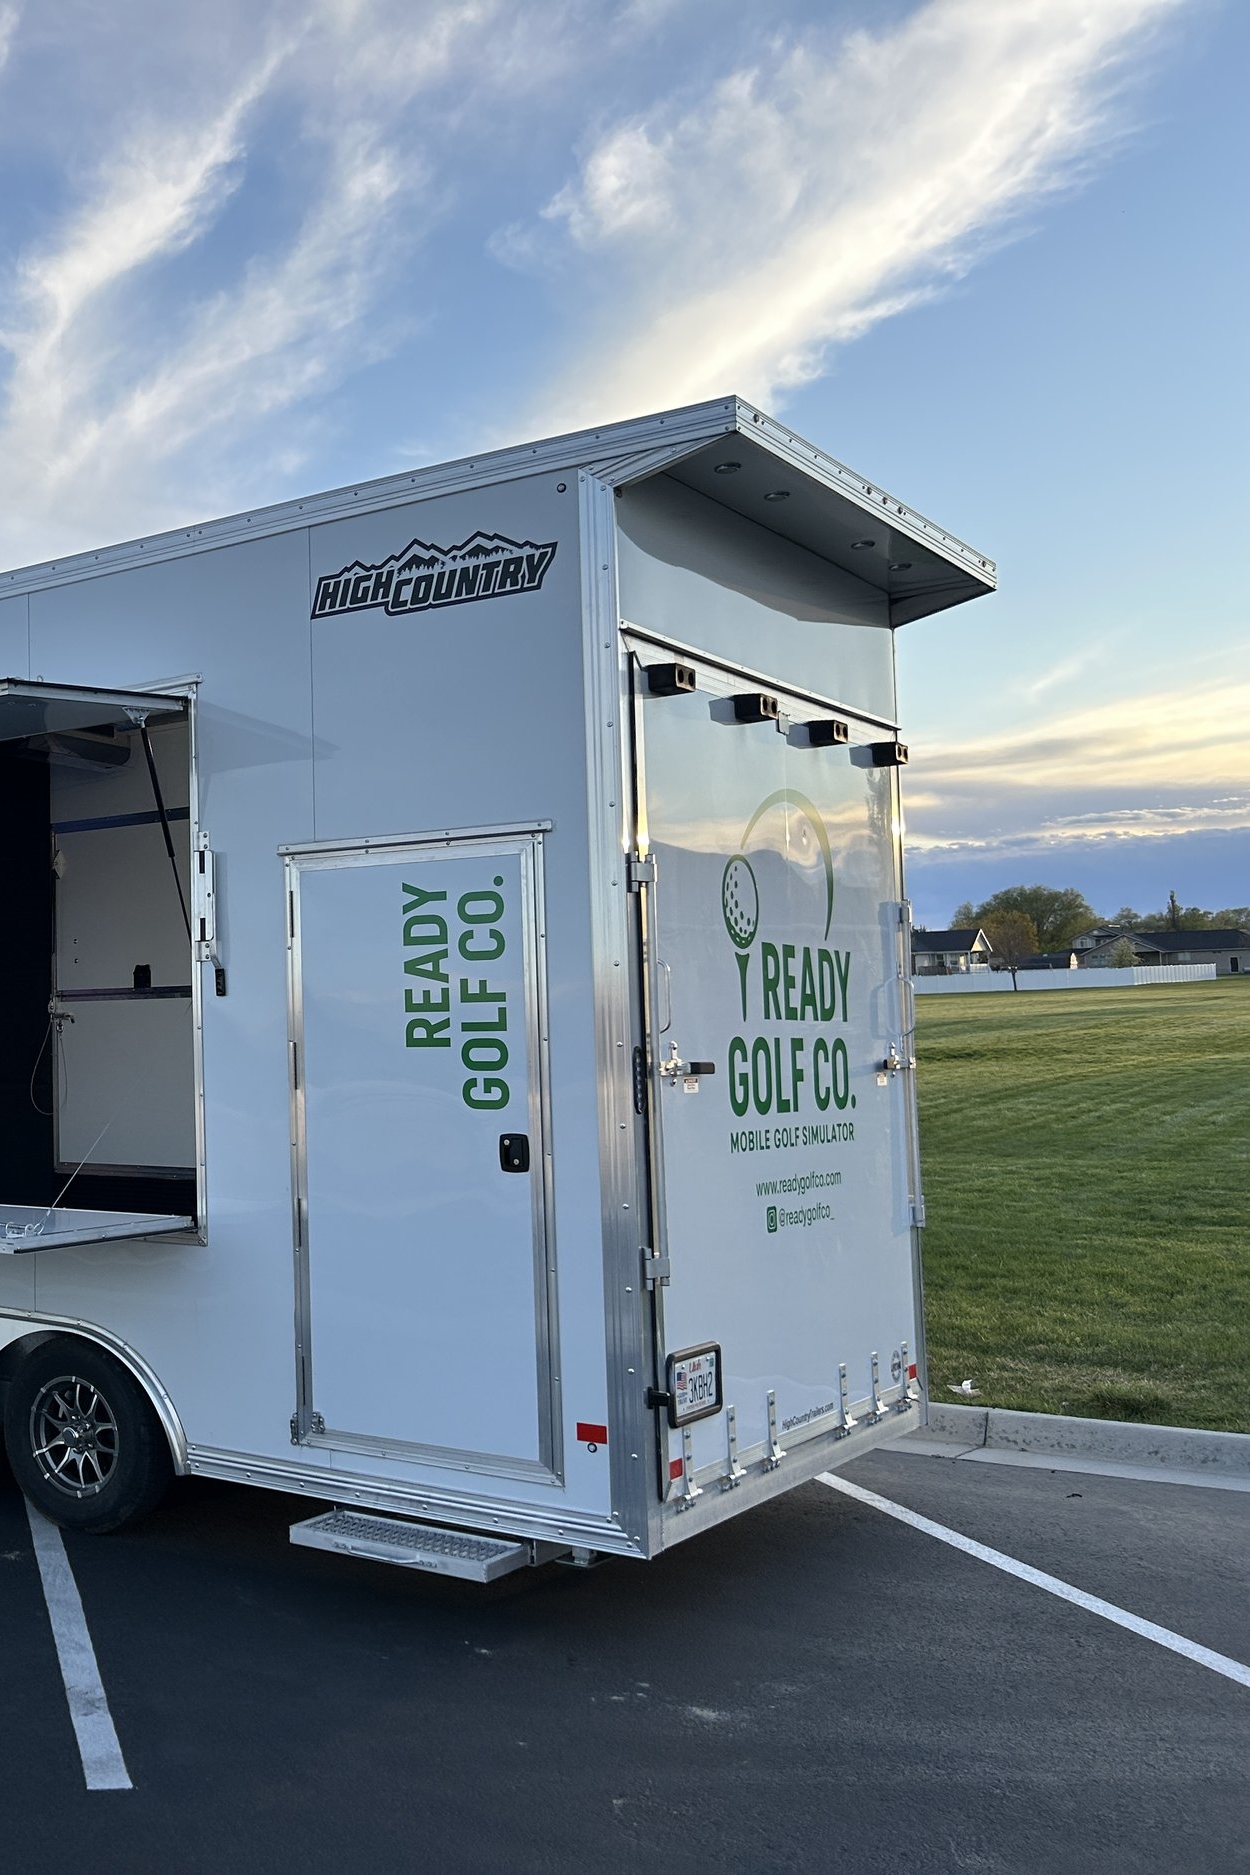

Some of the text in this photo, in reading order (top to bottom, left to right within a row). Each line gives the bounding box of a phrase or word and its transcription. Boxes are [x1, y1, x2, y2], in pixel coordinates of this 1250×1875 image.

[401, 881, 452, 1048] READY
[457, 875, 511, 1111] GOLF CO.
[761, 941, 851, 1023] READY
[727, 1036, 857, 1118] GOLF CO.
[730, 1122, 855, 1154] MOBILE GOLF SIMULATOR
[756, 1170, 842, 1197] www.readygolfco.com
